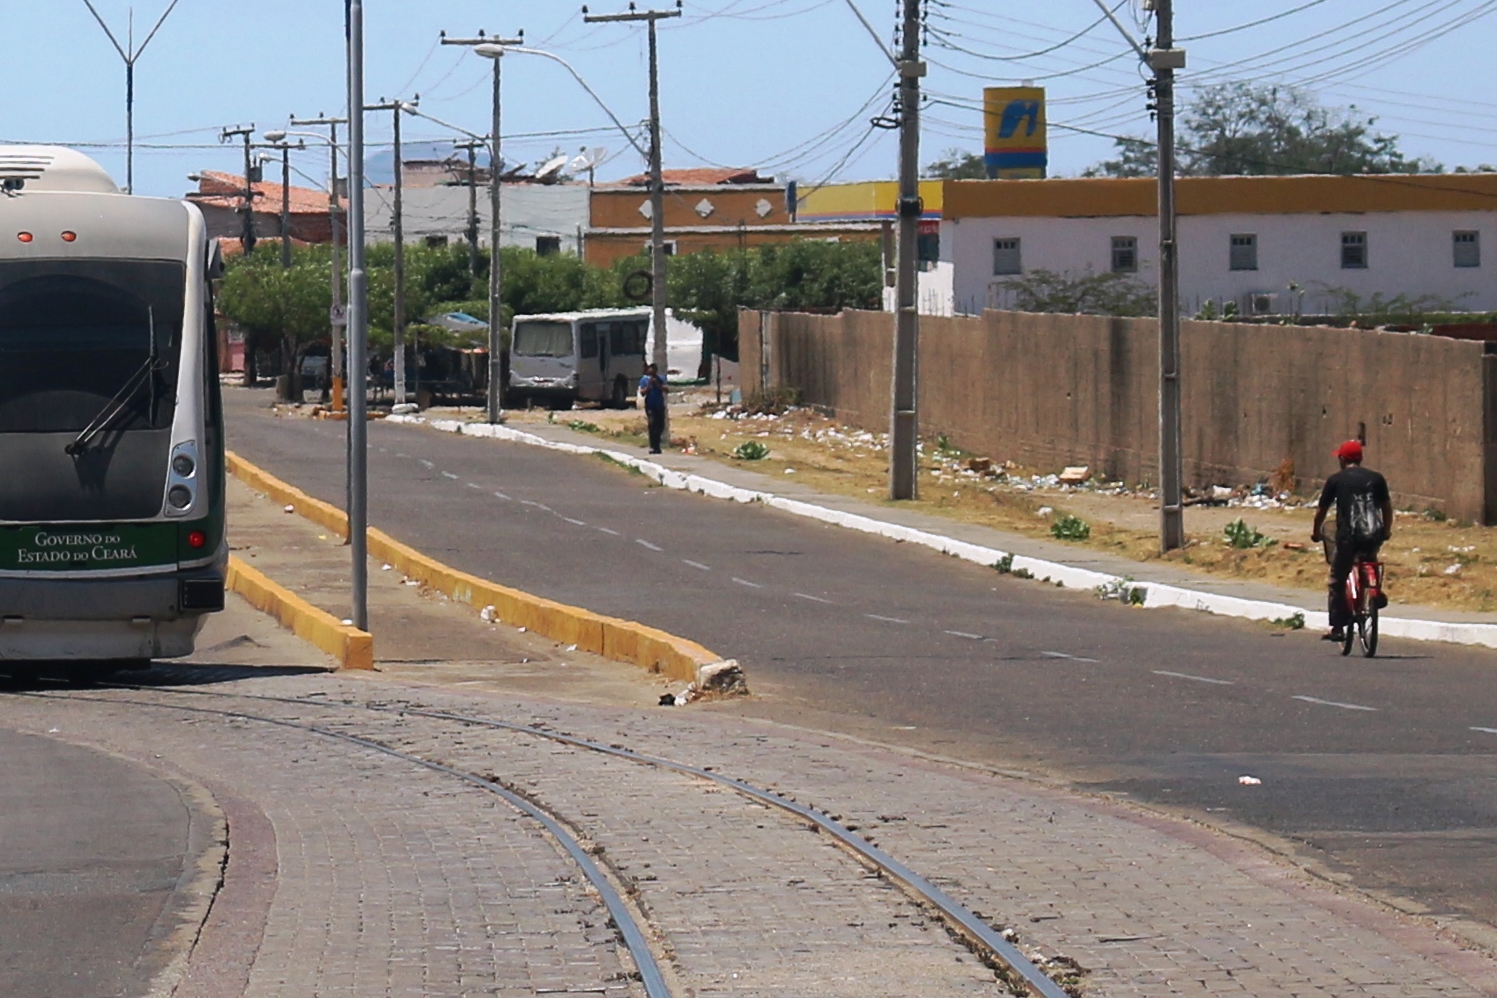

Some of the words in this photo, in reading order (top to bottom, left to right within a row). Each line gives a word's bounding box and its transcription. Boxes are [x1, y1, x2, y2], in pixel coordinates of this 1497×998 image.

[35, 532, 102, 546] GOVERNO
[105, 535, 121, 544] DO
[18, 549, 71, 563] ESTADO
[73, 552, 89, 561] DO
[91, 545, 138, 560] CEARÁ
